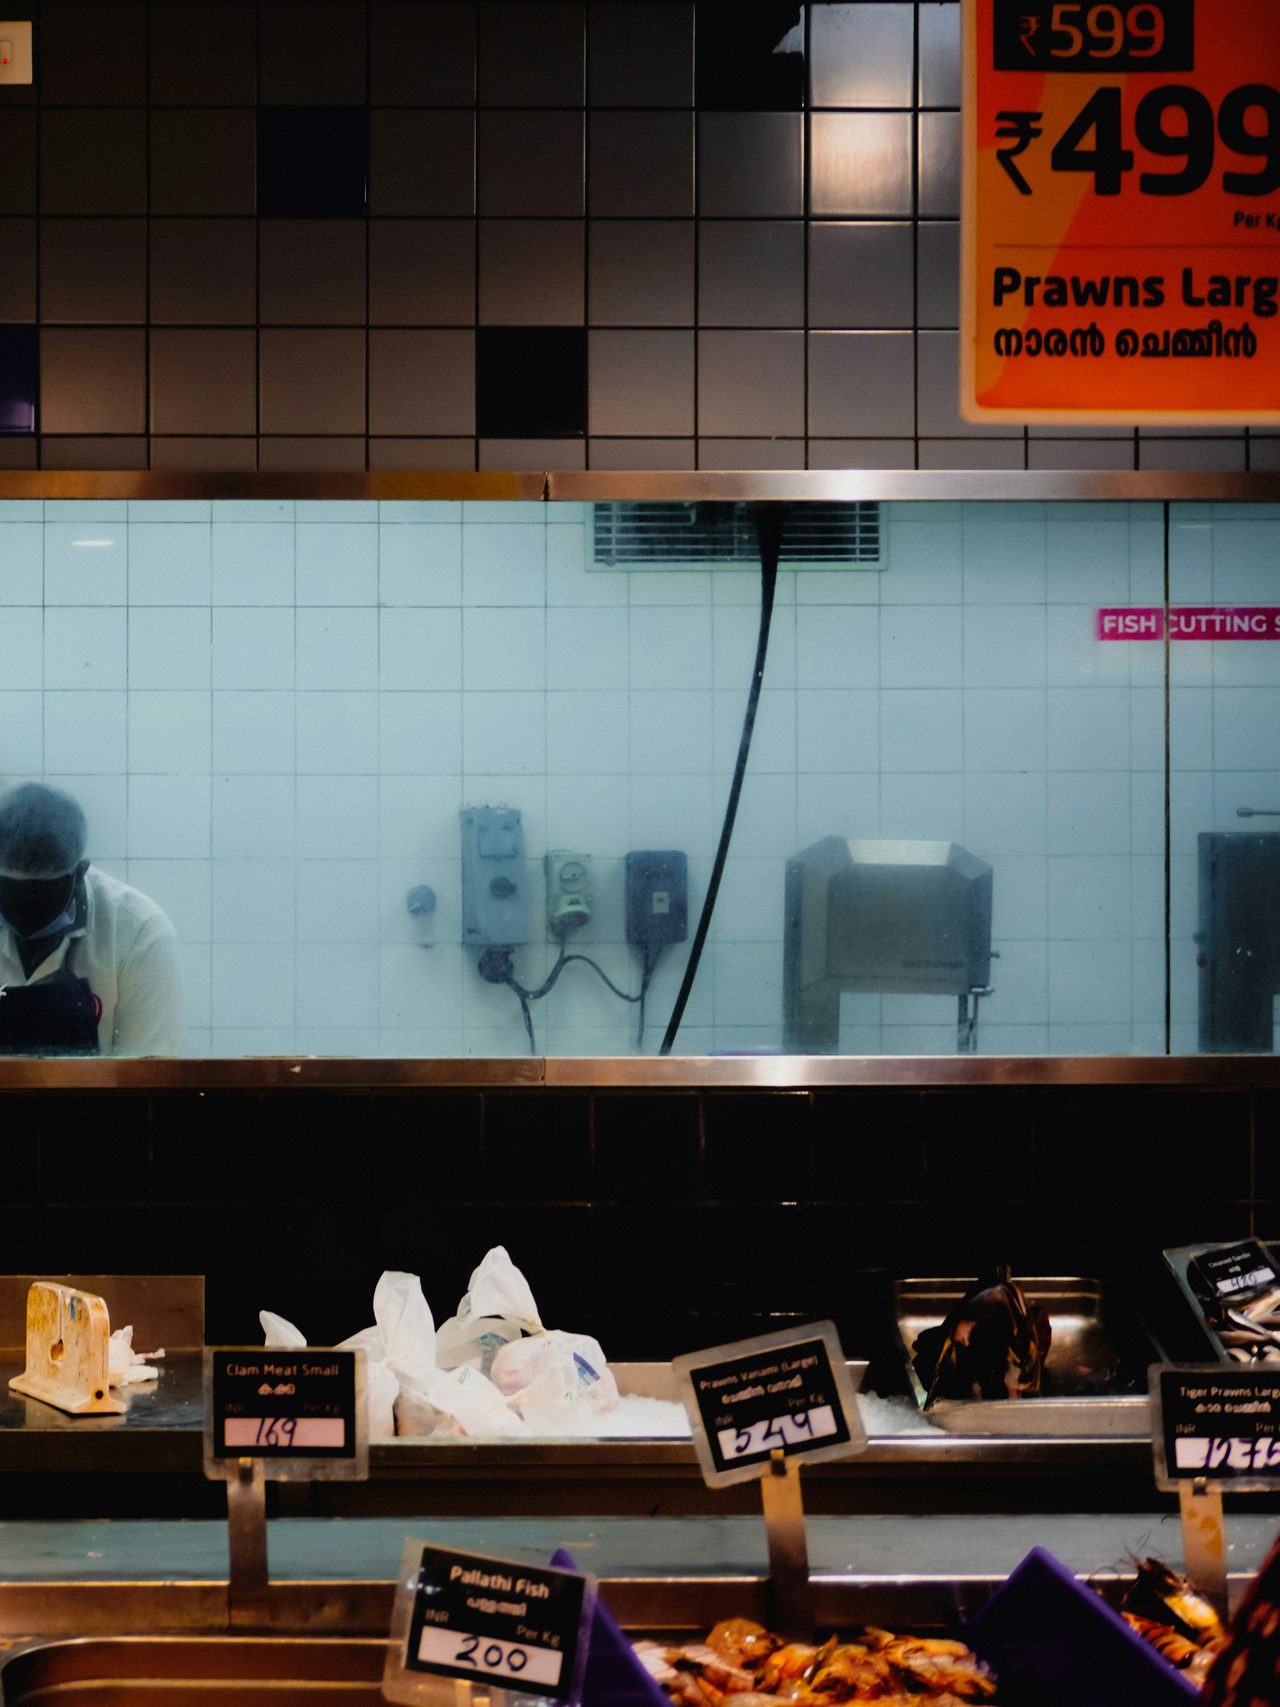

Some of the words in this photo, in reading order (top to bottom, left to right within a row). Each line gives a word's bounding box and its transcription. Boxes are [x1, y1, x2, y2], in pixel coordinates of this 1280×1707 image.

[1019, 3, 1165, 58] ₹599
[995, 84, 1280, 196] ₹499
[1234, 211, 1260, 227] Per
[993, 267, 1165, 307] Prawns
[1182, 267, 1278, 317] Larg
[994, 325, 1104, 357] നാരൻ
[1115, 321, 1257, 358] ചെമ്മീൻ
[1103, 615, 1156, 633] FISH
[226, 1363, 259, 1376] Clam
[263, 1363, 297, 1376] Meat
[302, 1363, 339, 1376] Small
[699, 1374, 738, 1391] Prawns
[781, 1355, 819, 1374] (Large)
[1180, 1386, 1207, 1399] Tiger
[1210, 1386, 1252, 1397] Prawns
[256, 1416, 297, 1448] 169
[734, 1410, 814, 1453] 549
[450, 1565, 512, 1592] Pallathi
[515, 1578, 550, 1599] Fish
[425, 1609, 449, 1623] INR
[516, 1625, 538, 1641] Per
[542, 1631, 560, 1647] Kg
[455, 1635, 528, 1672] 200
